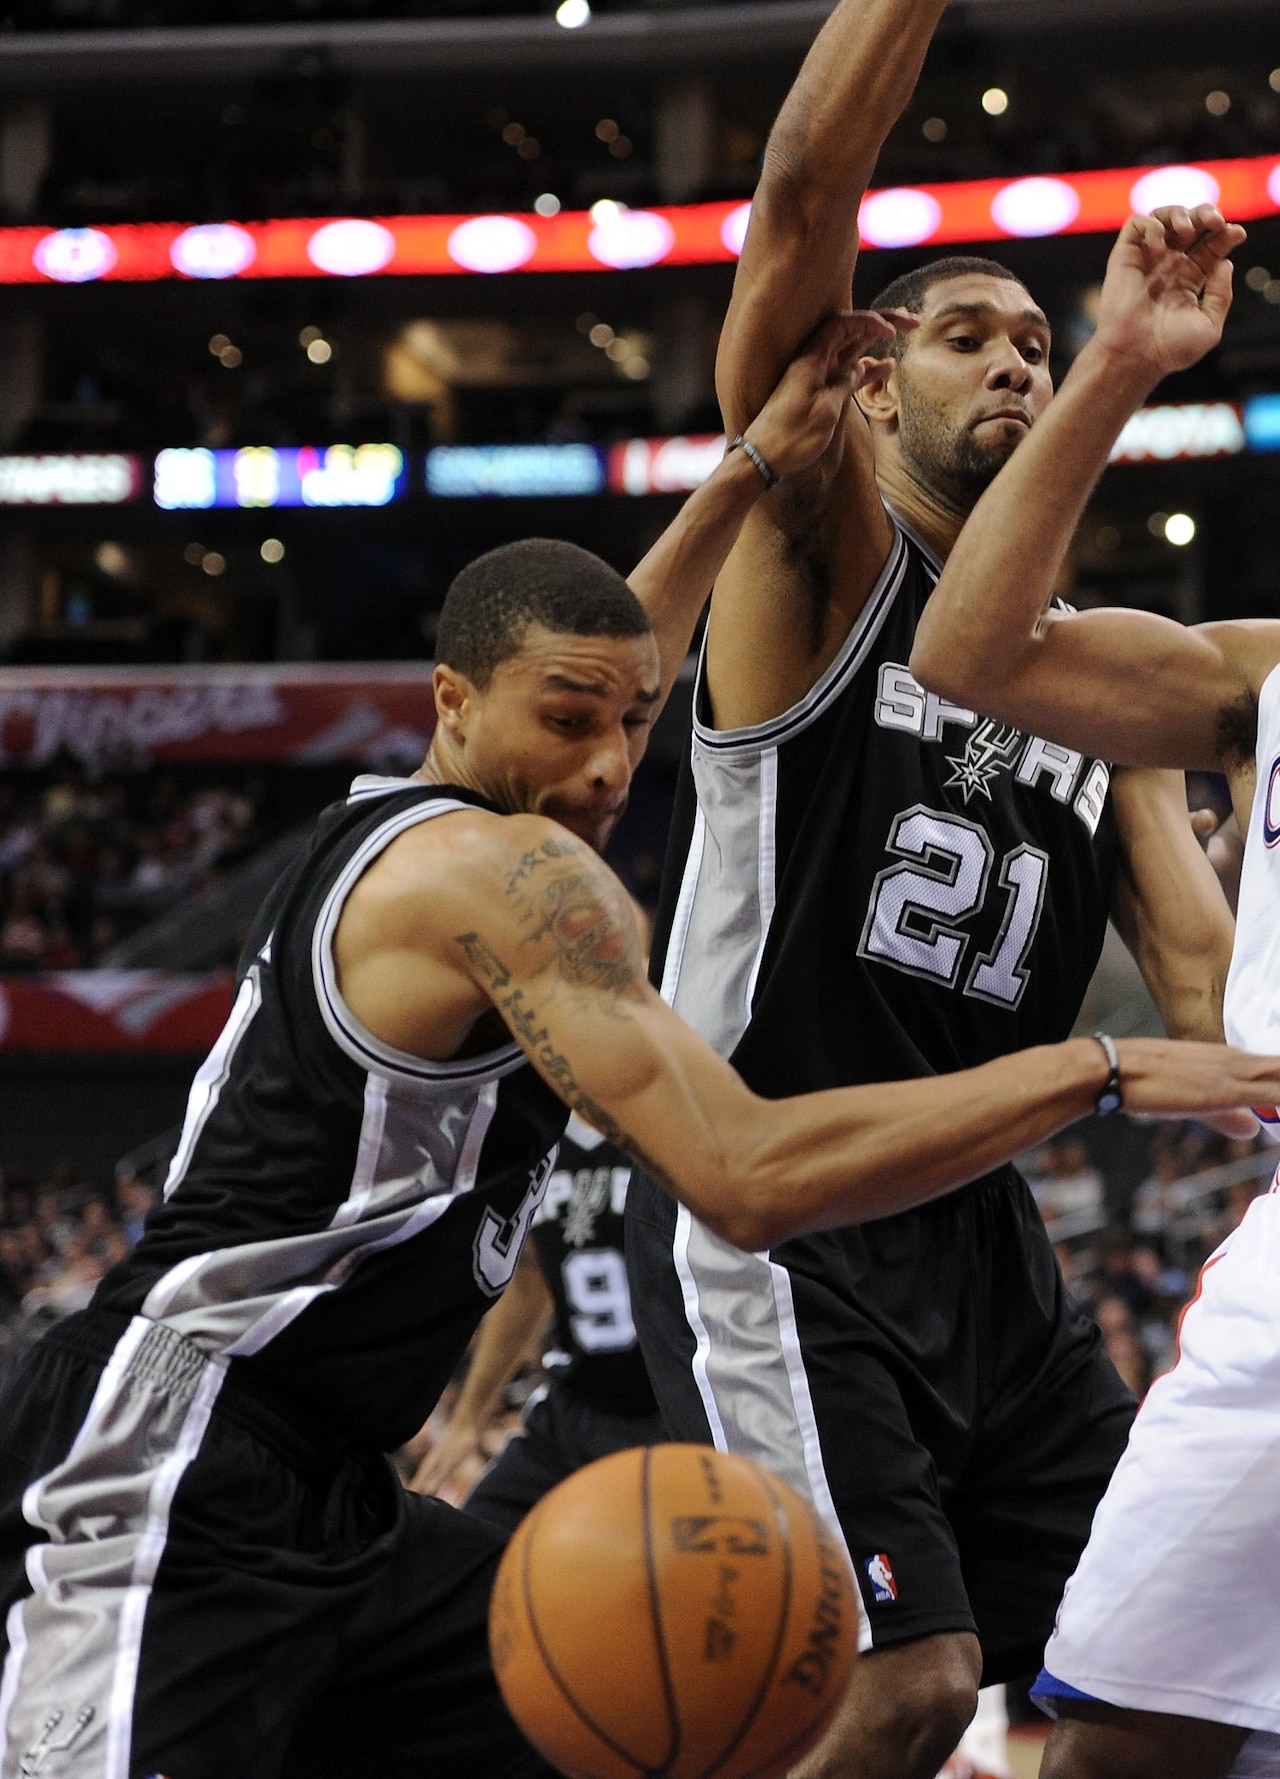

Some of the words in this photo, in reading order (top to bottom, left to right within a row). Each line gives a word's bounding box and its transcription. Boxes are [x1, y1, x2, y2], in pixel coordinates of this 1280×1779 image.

[0, 455, 131, 503] TAPLES
[856, 803, 1049, 1012] 21
[561, 1248, 637, 1354] 9
